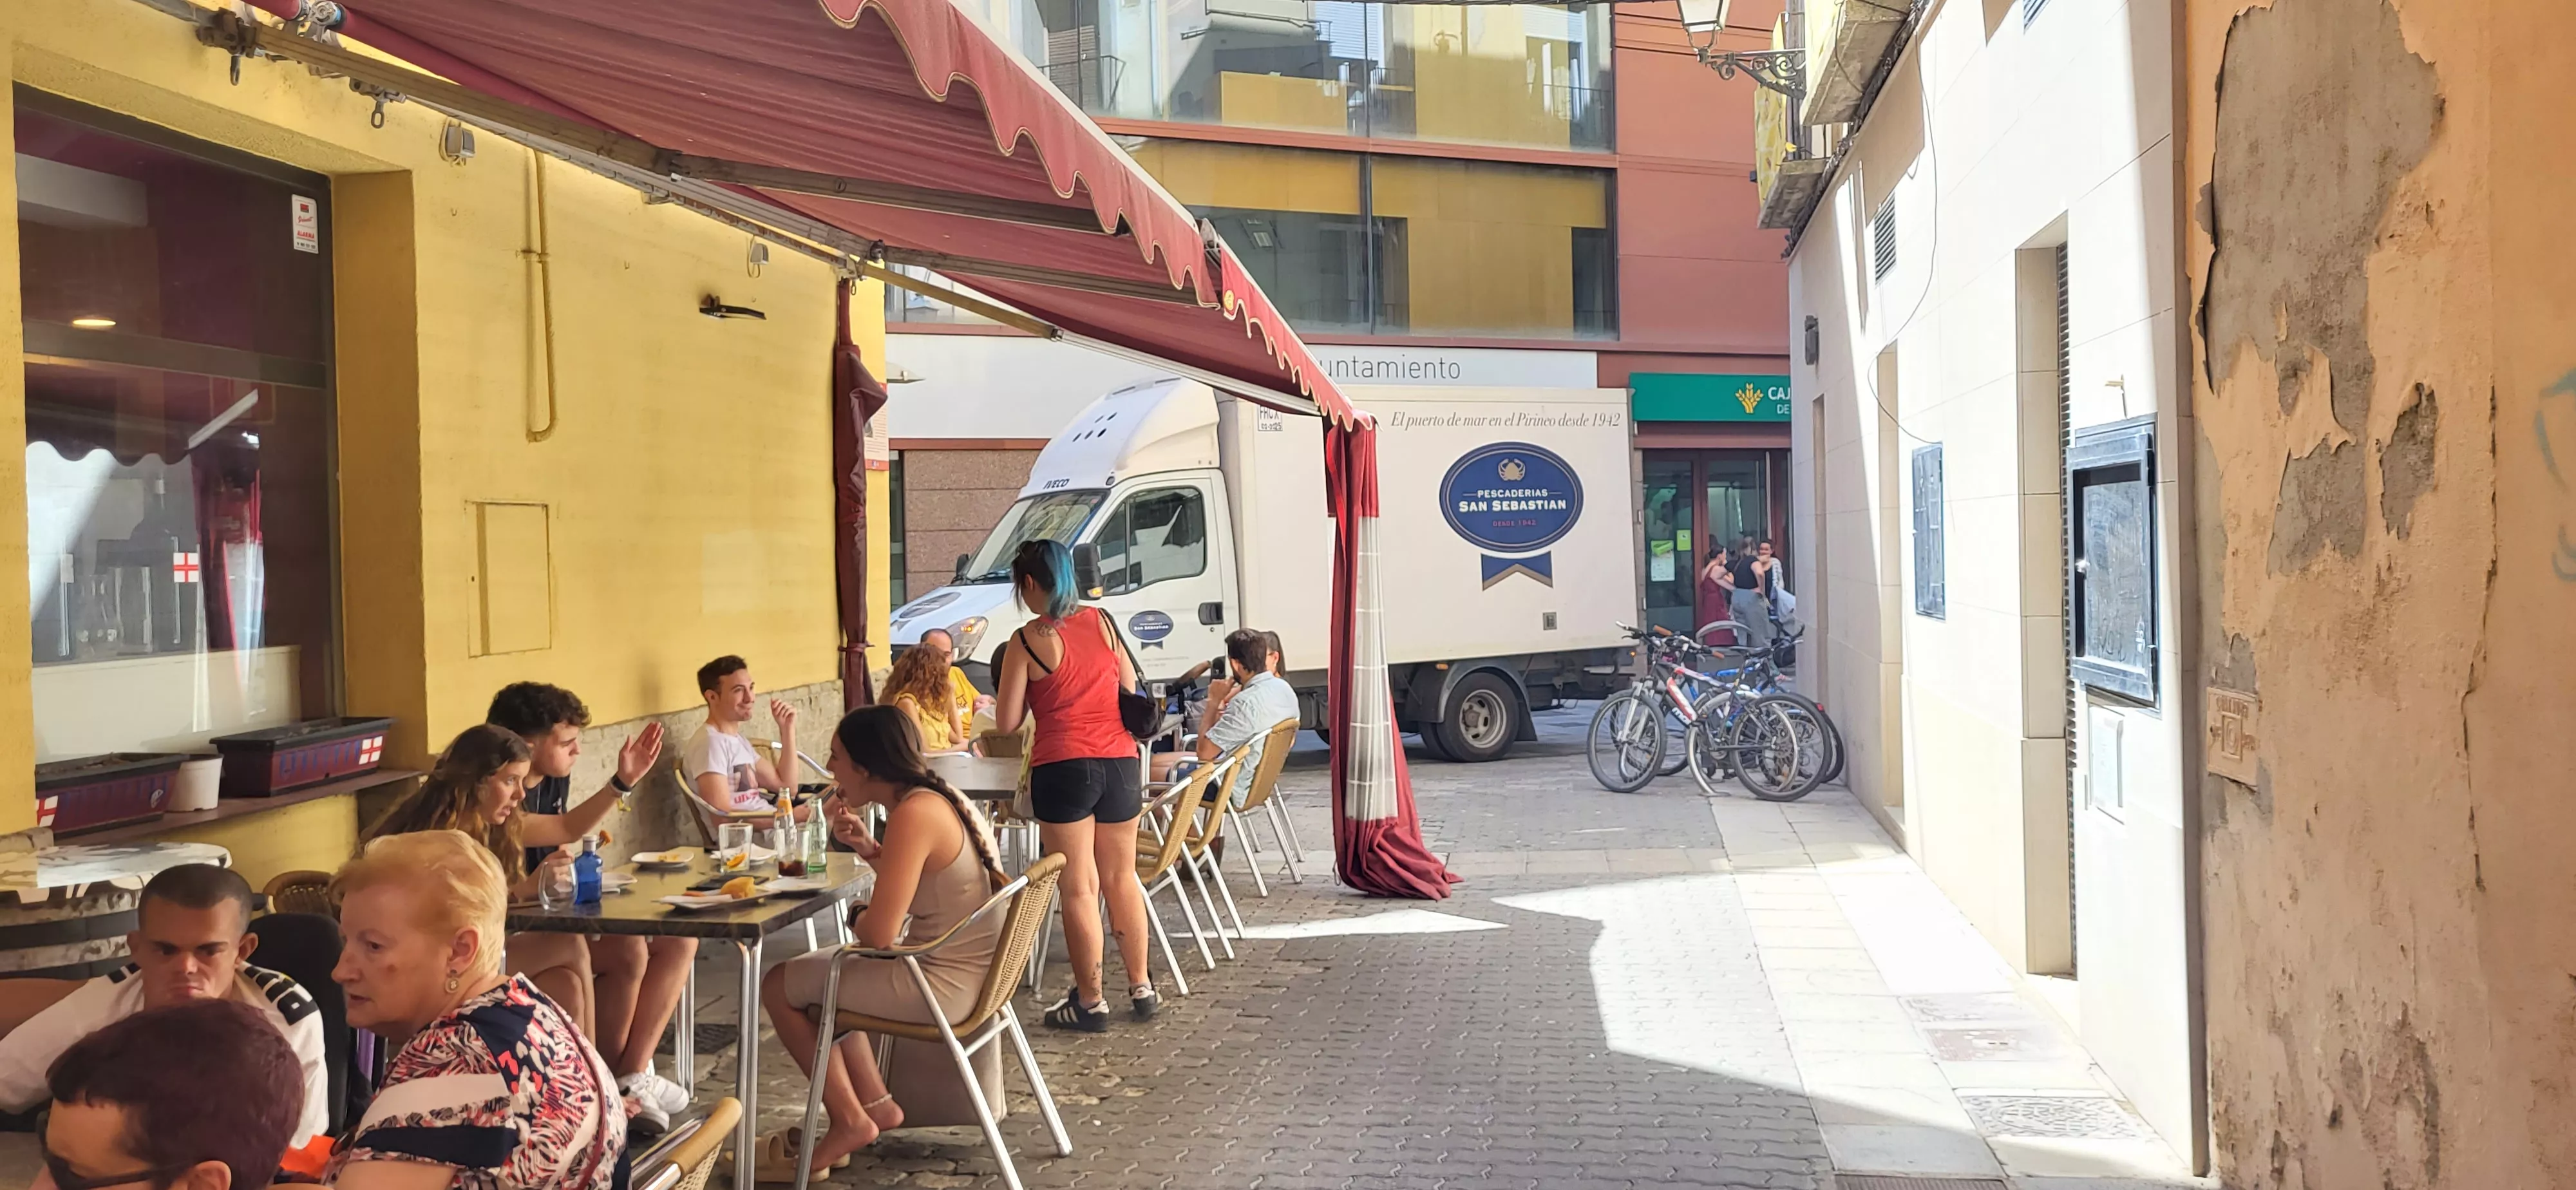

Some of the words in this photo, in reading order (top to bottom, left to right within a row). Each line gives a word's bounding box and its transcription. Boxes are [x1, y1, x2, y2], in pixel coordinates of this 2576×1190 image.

[1777, 404, 1790, 414] DE
[1391, 411, 1405, 426] El
[1405, 415, 1444, 431] puerto
[1446, 411, 1461, 427] de
[1463, 416, 1488, 427] mar
[1488, 416, 1502, 427] en
[1504, 412, 1515, 427] el
[1517, 412, 1556, 427] Pirineo
[1558, 412, 1589, 427] desde
[1591, 413, 1621, 427] 1942
[1043, 478, 1070, 489] IVECO
[1477, 488, 1548, 498] PESCADERIAS
[1459, 500, 1488, 513] SAN
[1492, 499, 1567, 512] SEBASTIAN
